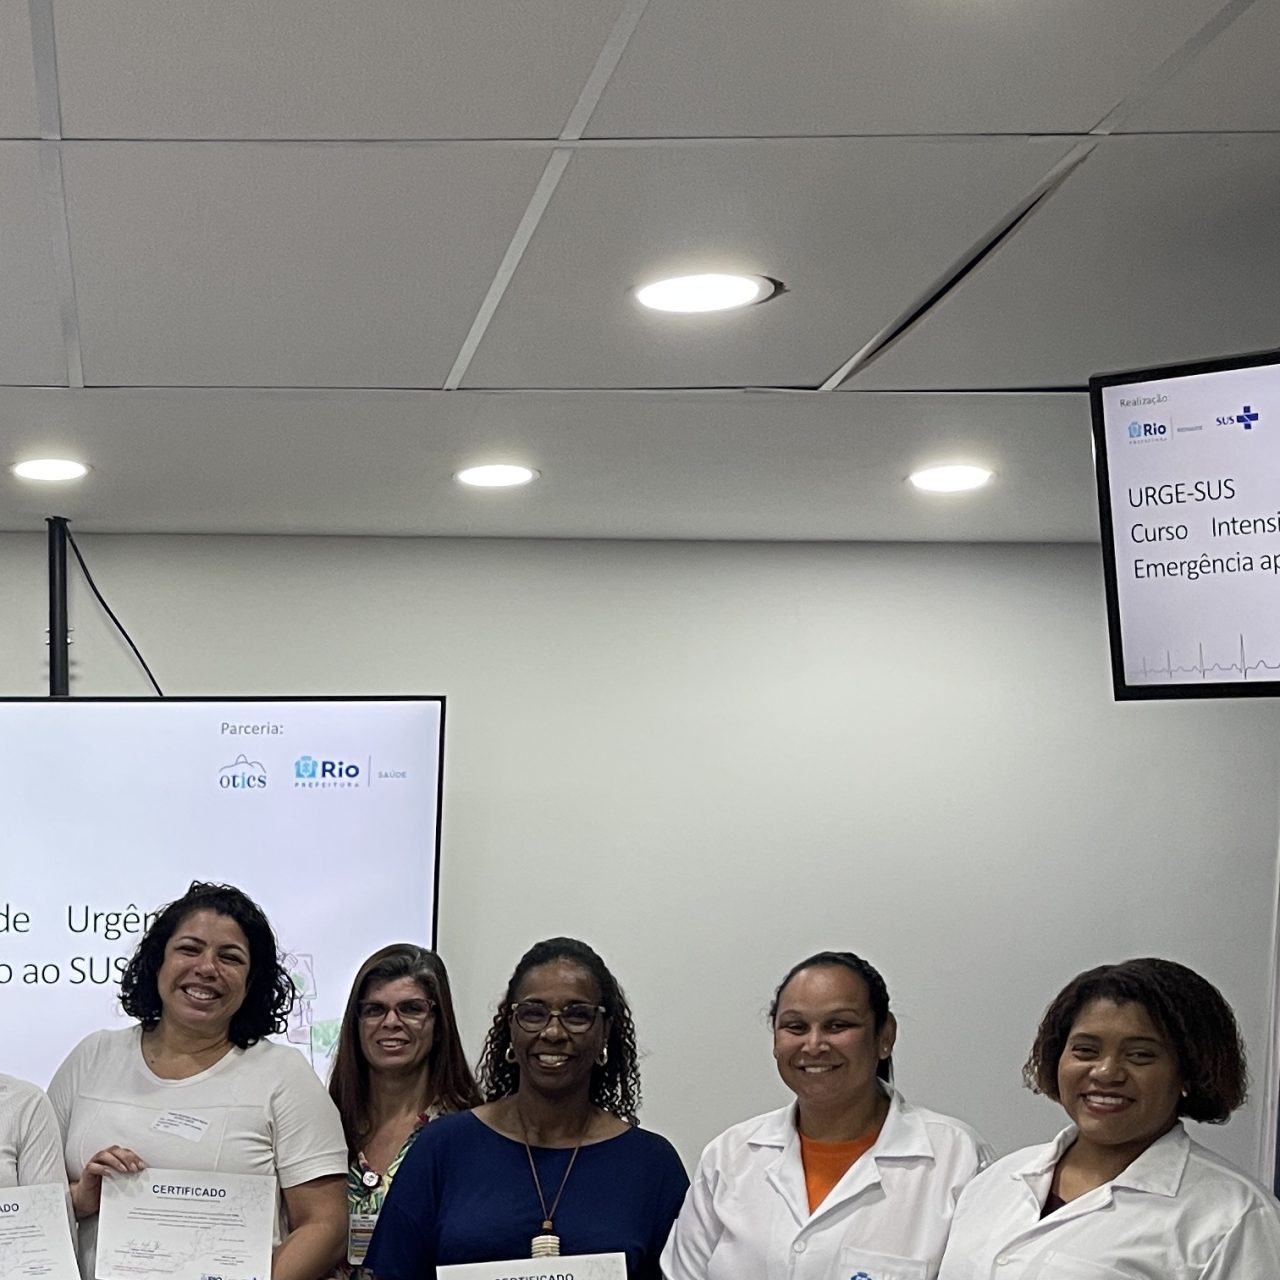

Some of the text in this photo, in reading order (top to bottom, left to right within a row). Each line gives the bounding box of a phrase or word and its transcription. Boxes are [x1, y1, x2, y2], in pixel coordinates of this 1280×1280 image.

[1143, 422, 1167, 436] Rio
[1216, 416, 1235, 426] SUS
[1129, 478, 1236, 508] URGE-SUS
[1131, 523, 1188, 543] Curso
[1134, 552, 1254, 580] Emergência
[221, 722, 284, 735] Parceria:
[320, 761, 360, 779] Rio
[220, 772, 267, 789] otics
[67, 903, 158, 940] Urgên
[23, 963, 60, 984] ao
[152, 1184, 227, 1198] CERTIFICADO
